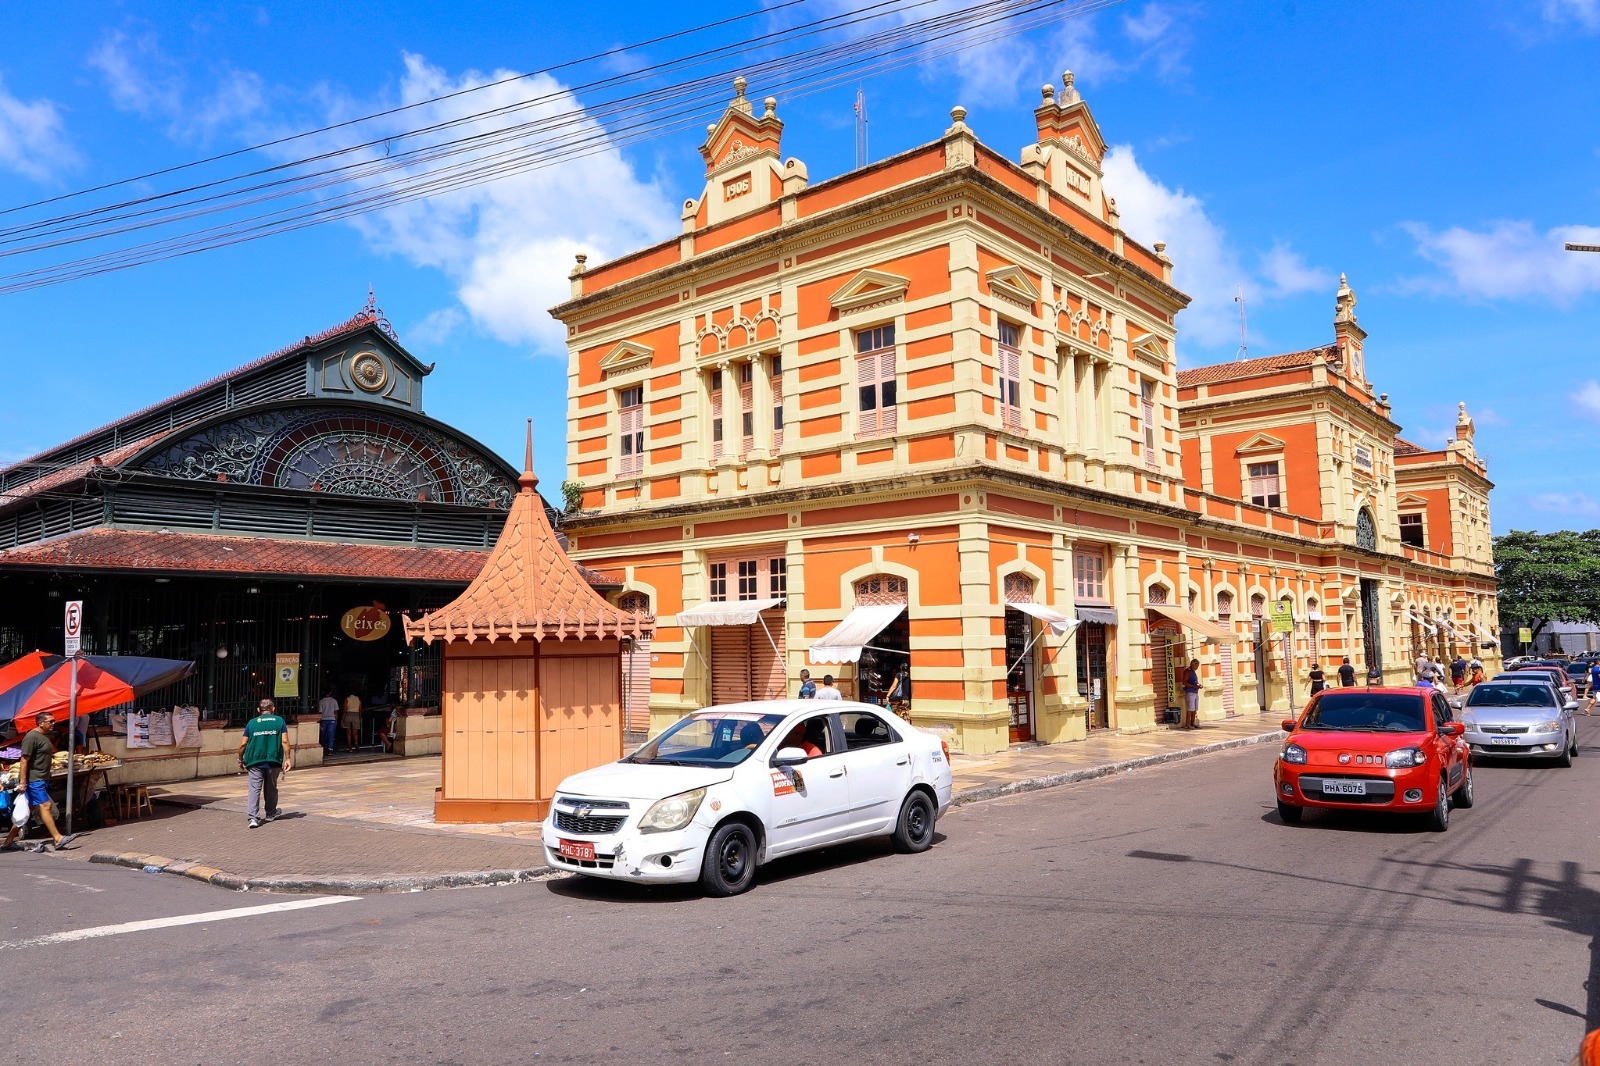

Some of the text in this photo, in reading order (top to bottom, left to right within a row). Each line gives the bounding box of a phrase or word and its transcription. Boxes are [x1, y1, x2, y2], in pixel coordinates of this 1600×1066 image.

[726, 179, 749, 198] 1906
[69, 609, 77, 629] E
[345, 614, 387, 630] Peixes
[1166, 639, 1174, 703] RESTAURANTE
